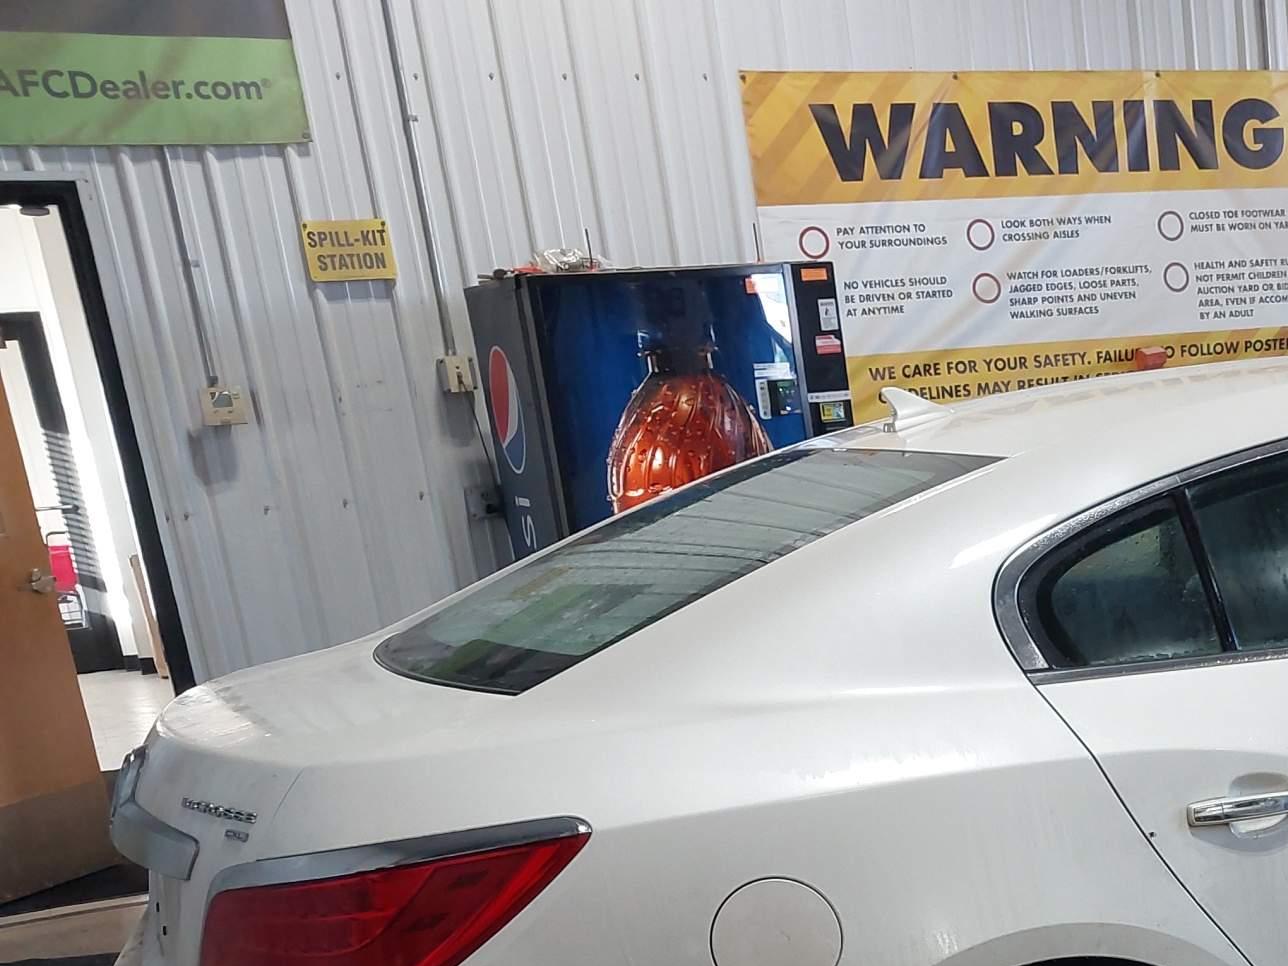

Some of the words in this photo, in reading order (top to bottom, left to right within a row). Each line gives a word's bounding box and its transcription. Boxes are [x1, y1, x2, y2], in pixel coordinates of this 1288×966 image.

[808, 98, 1284, 182] WARNING
[1189, 211, 1220, 220] CLOSED
[1223, 210, 1238, 219] TOE
[1241, 209, 1286, 218] FOOTWEAR
[1001, 219, 1026, 229] LOOK
[1029, 218, 1054, 227] BOTH
[1056, 217, 1082, 226] WAYS
[1084, 215, 1111, 225] WHEN
[1191, 224, 1213, 233] MUST
[1216, 223, 1225, 232] BE
[1228, 222, 1256, 231] WORN
[1259, 221, 1272, 230] ON
[836, 227, 855, 236] PAY
[859, 224, 910, 235] ATTENTION
[913, 223, 926, 233] TO
[1002, 232, 1050, 242] CROSSING
[1053, 230, 1080, 239] AISLES
[307, 229, 386, 248] SPILL-KIT
[838, 240, 867, 250] YOUR
[869, 236, 948, 249] SURROUNDINGS
[317, 252, 387, 271] STATION
[1194, 261, 1225, 270] HEALTH
[1227, 260, 1247, 269] AND
[1249, 258, 1278, 267] SAFETY
[1007, 271, 1038, 281] WATCH
[1041, 270, 1058, 279] FOR
[1195, 274, 1214, 283] NOT
[1216, 272, 1245, 281] PERMIT
[1248, 270, 1287, 280] CHILDREN
[844, 281, 859, 290] NO
[861, 278, 906, 289] VEHICLES
[908, 276, 947, 287] SHOULD
[1009, 283, 1042, 294] JAGGED
[1046, 282, 1076, 292] EDGES,
[1078, 280, 1107, 290] LOOSE
[1197, 285, 1235, 295] AUCTION
[1238, 284, 1259, 293] YARD
[1262, 283, 1274, 291] OR
[845, 294, 855, 304] BE
[859, 292, 895, 303] DRIVEN
[898, 291, 912, 300] OR
[915, 289, 953, 300] STARTED
[1009, 296, 1038, 306] SHARP
[1041, 294, 1074, 305] POINTS
[1077, 293, 1097, 302] AND
[1100, 291, 1137, 301] UNEVEN
[1225, 296, 1247, 306] EVEN
[1249, 296, 1256, 304] IF
[846, 308, 858, 318] AT
[860, 305, 905, 316] ANYTIME
[1009, 308, 1054, 319] WALKING
[1056, 305, 1100, 317] SURFACES
[1199, 311, 1210, 320] BY
[1213, 310, 1226, 319] AN
[1228, 309, 1254, 318] ADULT
[869, 366, 897, 382] WE
[902, 362, 941, 379] CARE
[946, 359, 978, 375] FOR
[982, 356, 1028, 372] YOUR
[1033, 351, 1092, 369] SAFETY.
[1096, 347, 1142, 364] FAILU
[1180, 341, 1240, 358] FOLLOW
[977, 380, 1012, 396] MAY
